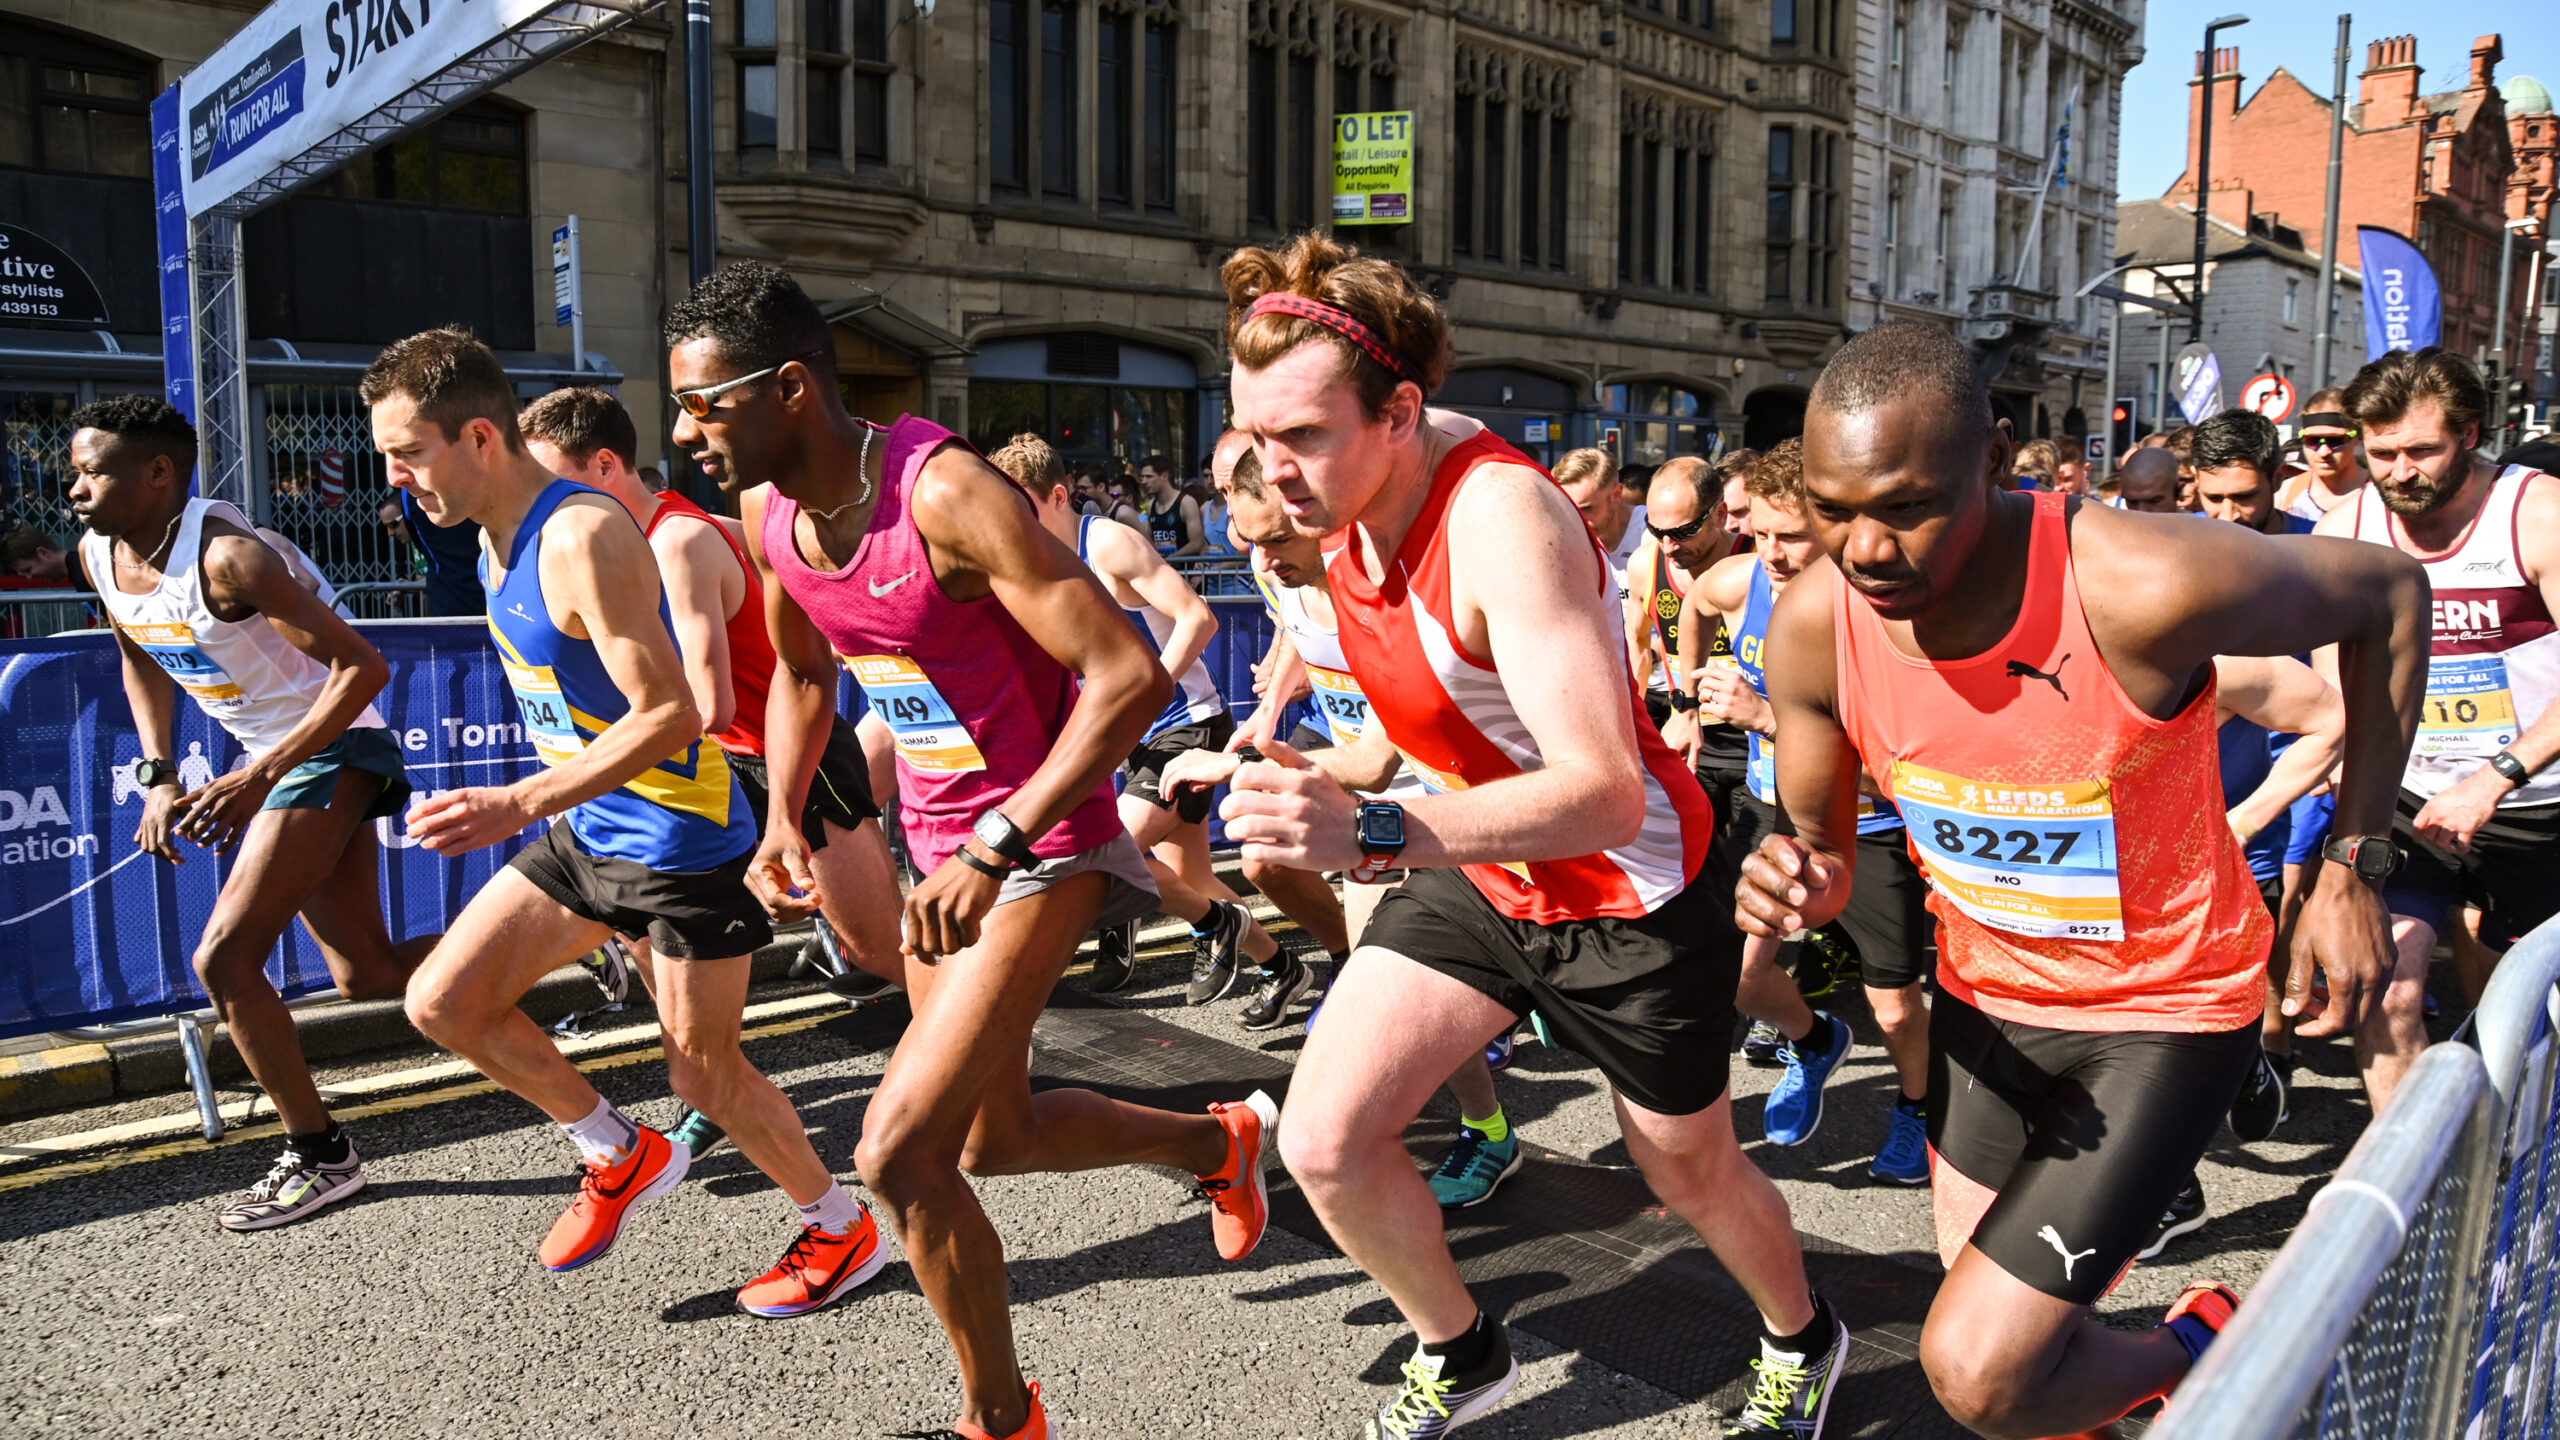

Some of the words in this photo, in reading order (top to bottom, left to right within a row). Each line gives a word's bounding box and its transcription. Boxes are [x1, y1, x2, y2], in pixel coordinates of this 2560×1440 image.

[229, 84, 240, 101] Jane
[238, 57, 271, 93] Tomlinson's
[229, 111, 250, 146] RUN
[251, 95, 271, 132] FOR
[271, 81, 290, 117] ALL
[193, 123, 208, 146] ASDA
[1367, 115, 1409, 140] LET
[1333, 148, 1358, 161] etail
[1368, 148, 1408, 160] Leisure
[1335, 163, 1399, 178] Opportunity
[1357, 182, 1390, 192] Enquiries
[0, 256, 55, 279] tive
[0, 283, 64, 299] stylists
[1, 302, 58, 316] 439153
[2432, 599, 2501, 631] ERN
[2460, 631, 2483, 641] Club
[857, 660, 900, 675] LEEDS
[2442, 675, 2466, 685] FOR
[2468, 673, 2490, 683] ALL
[873, 696, 930, 722] 749
[1908, 775, 1946, 793] ASDA
[1904, 785, 1953, 801] Foundation
[1984, 790, 2066, 806] LEEDS
[1986, 805, 2021, 814] HALF
[2024, 804, 2103, 815] MARATHON
[0, 832, 99, 865] ation
[1933, 819, 2081, 865] 8227
[1995, 875, 2021, 886] MO
[1982, 898, 2005, 909] RUN
[2007, 901, 2029, 912] FOR
[2031, 904, 2050, 915] ALL
[2021, 924, 2043, 934] Label
[2069, 926, 2110, 936] 8227
